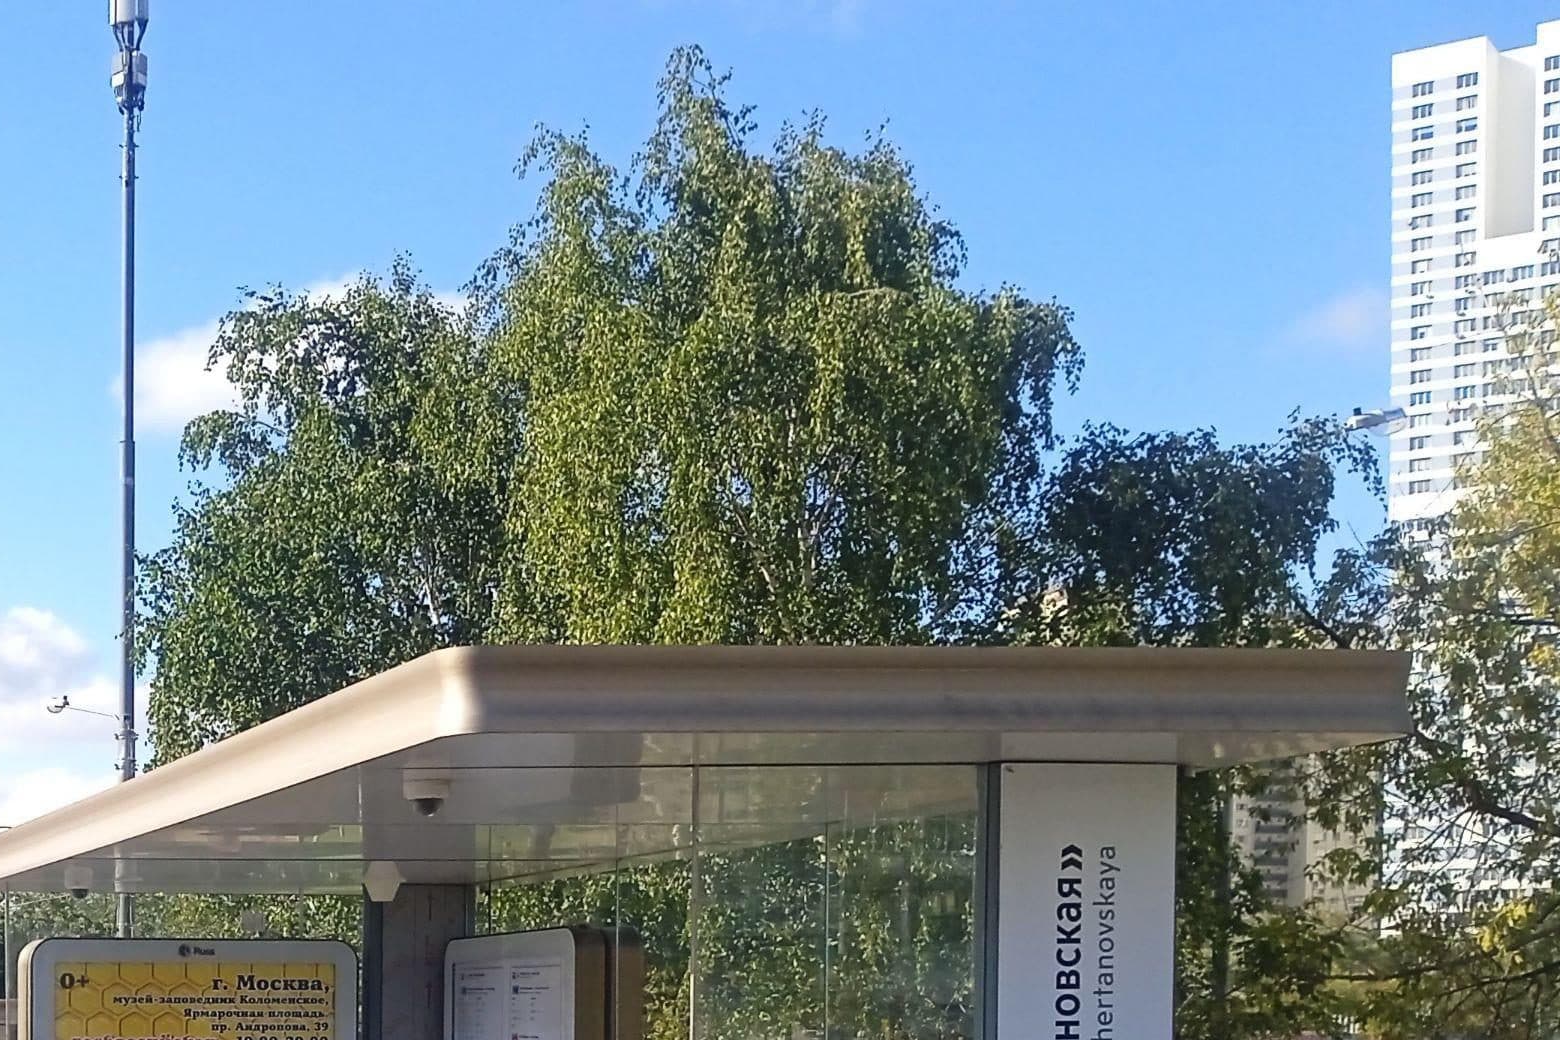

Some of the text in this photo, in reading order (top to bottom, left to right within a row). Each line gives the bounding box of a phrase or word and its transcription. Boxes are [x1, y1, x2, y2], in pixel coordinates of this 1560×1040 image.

[60, 973, 90, 990] 0+
[212, 975, 330, 993] г. Москва,
[112, 994, 329, 1006] музей-заповедник Коломенское,
[183, 1008, 265, 1019] Ярмарочная
[211, 1024, 230, 1033] пр.
[314, 1022, 329, 1032] 39
